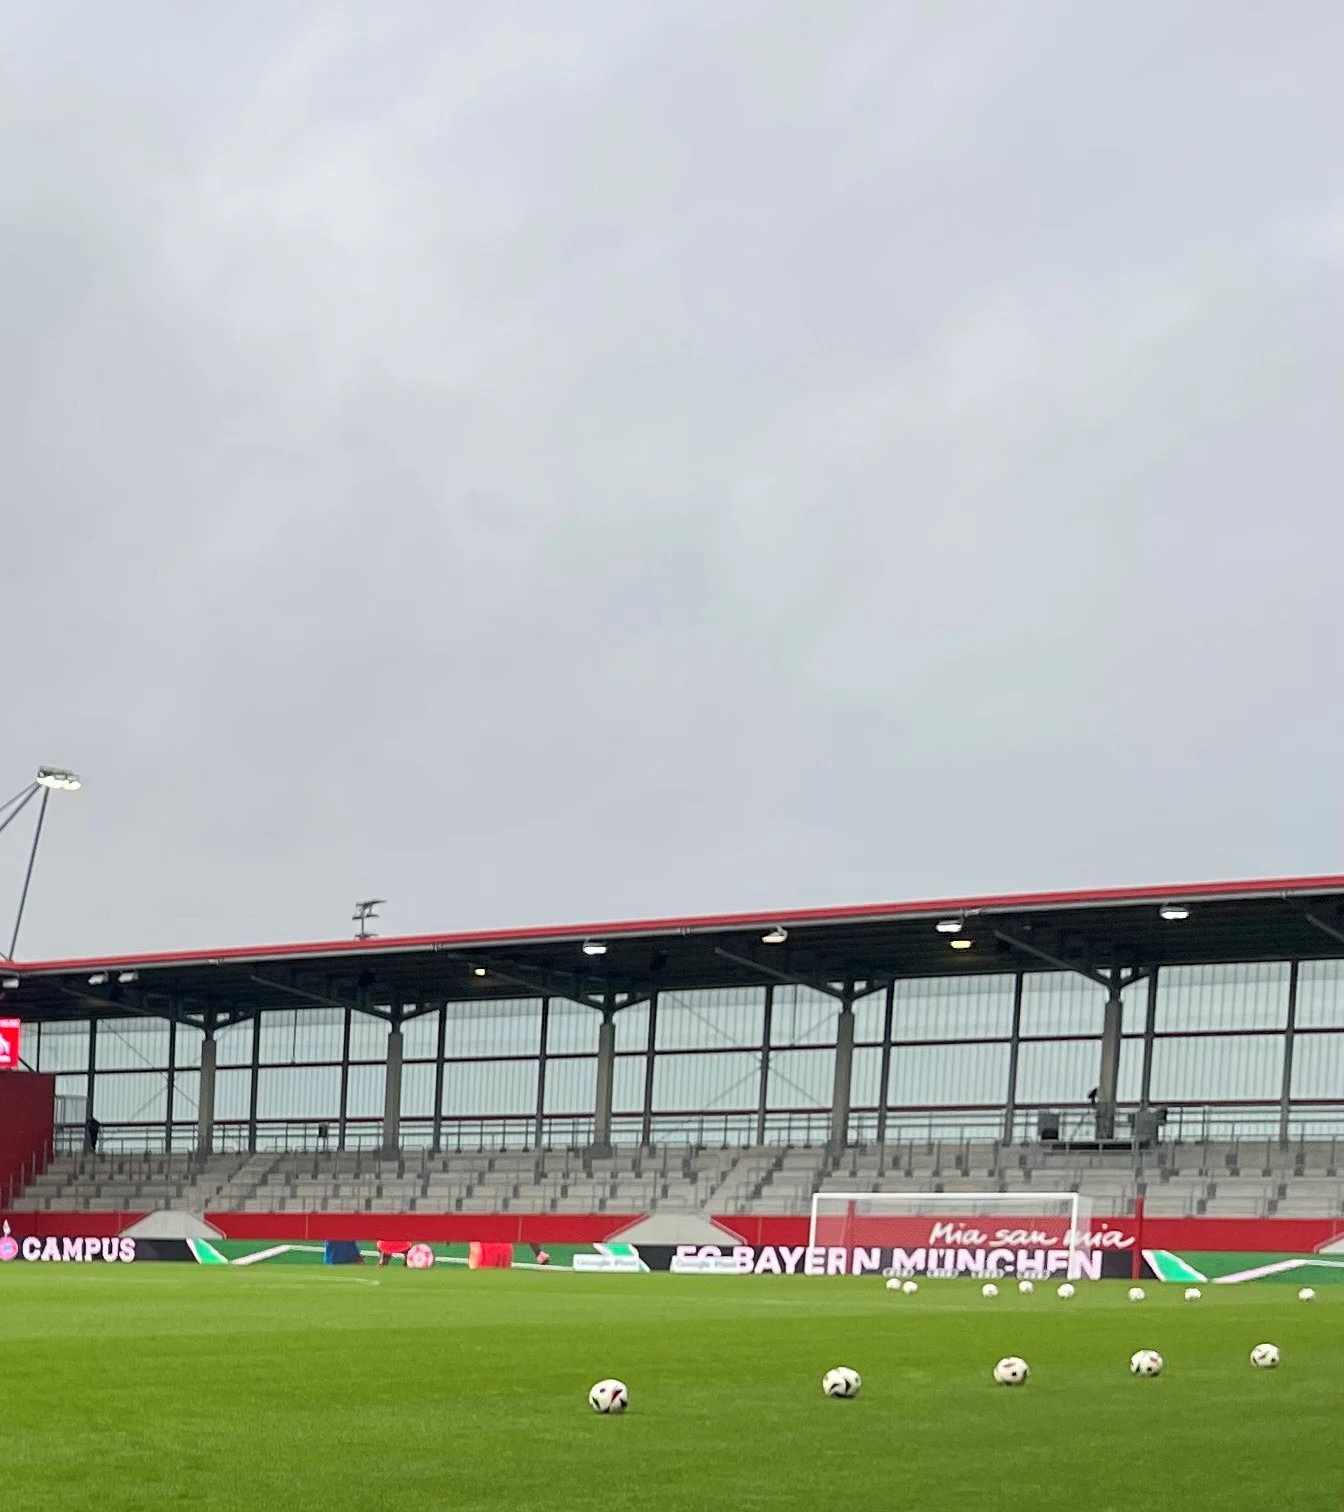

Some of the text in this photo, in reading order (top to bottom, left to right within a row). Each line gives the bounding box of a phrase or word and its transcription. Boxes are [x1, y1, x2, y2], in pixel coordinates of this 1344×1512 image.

[928, 1222, 987, 1246] Mia
[988, 1228, 1059, 1247] san
[22, 1236, 136, 1263] CAMPUS
[733, 1246, 881, 1275] BAYERN
